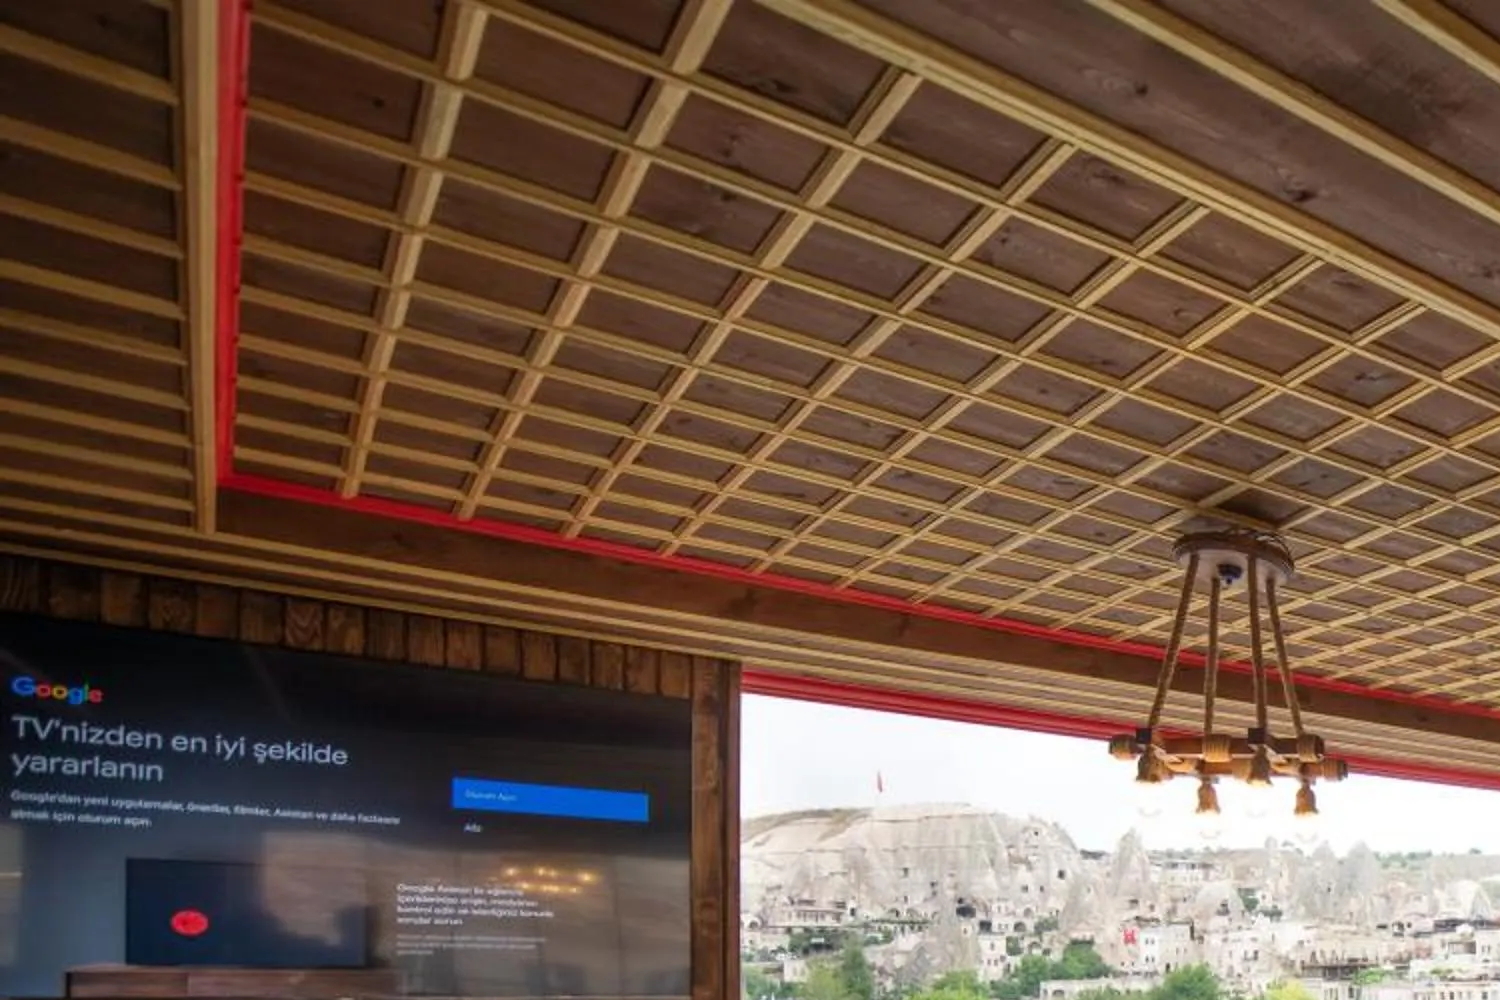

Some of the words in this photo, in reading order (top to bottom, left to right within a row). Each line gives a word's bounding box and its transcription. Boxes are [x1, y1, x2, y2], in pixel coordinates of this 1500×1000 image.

[11, 676, 103, 704] Google
[12, 714, 163, 749] TV'nizden
[171, 735, 207, 753] en
[215, 734, 246, 760] iyi
[253, 739, 348, 765] şekilde
[12, 753, 163, 782] yararlanın
